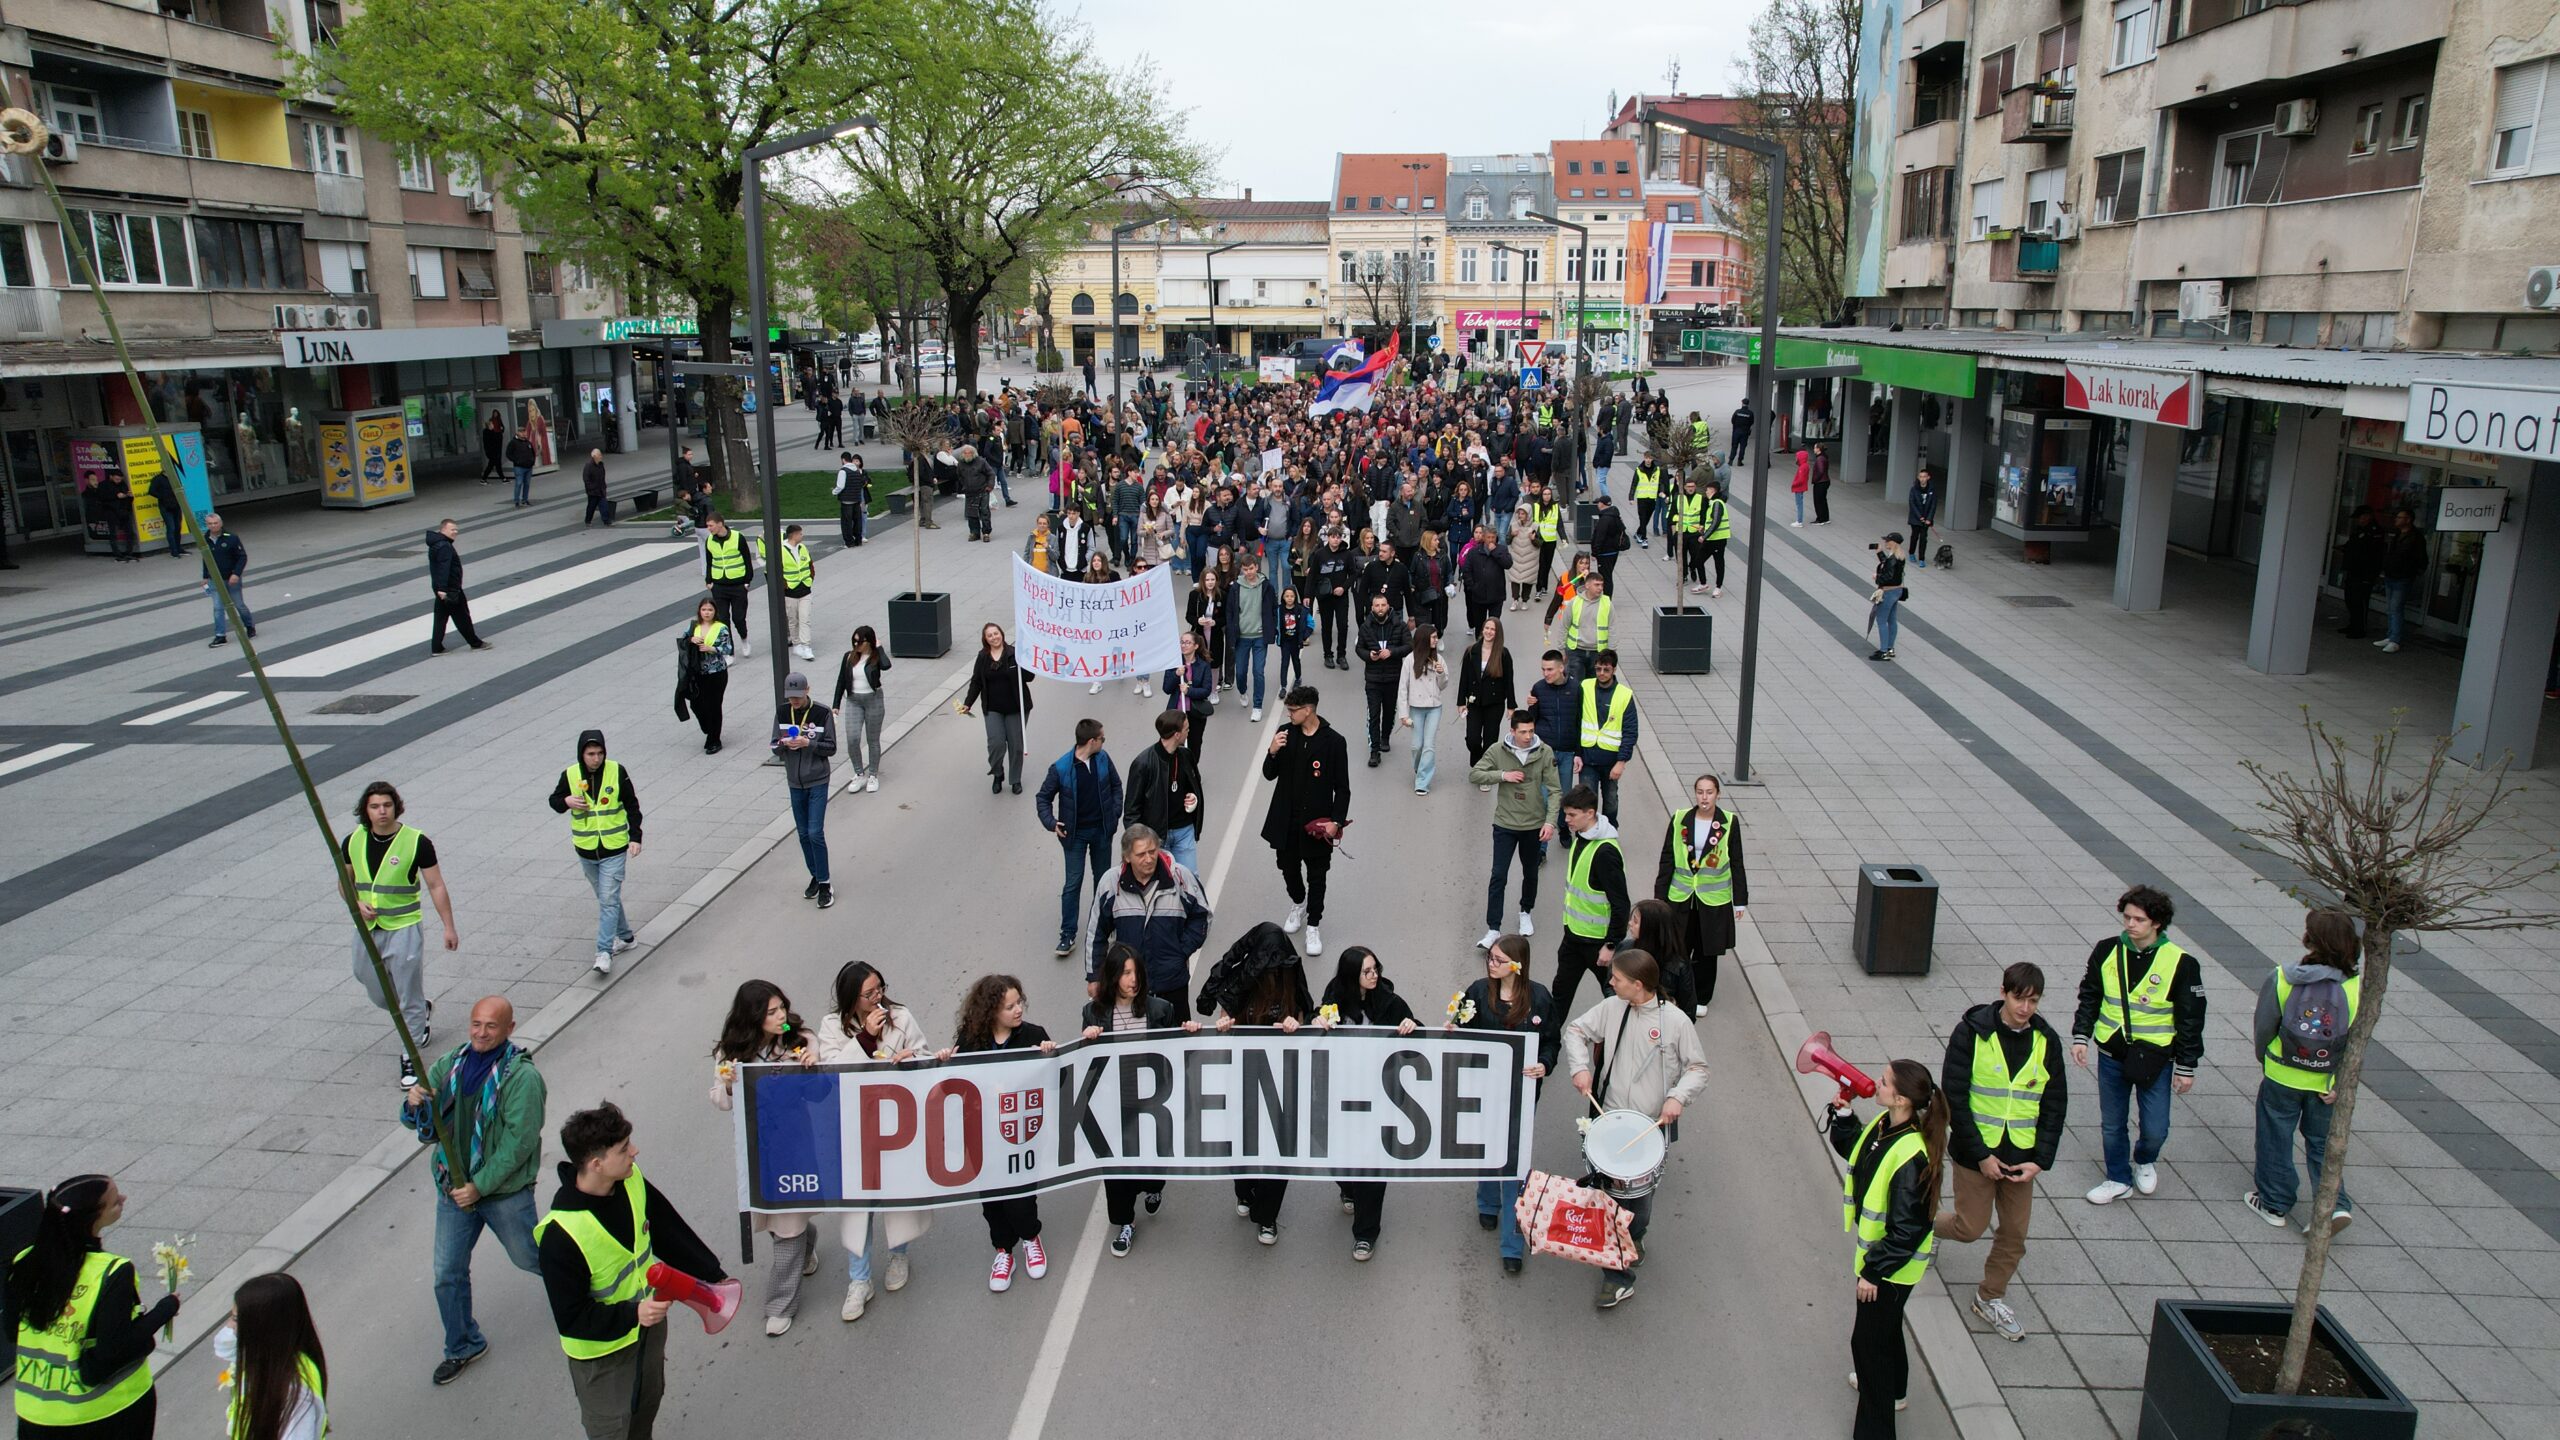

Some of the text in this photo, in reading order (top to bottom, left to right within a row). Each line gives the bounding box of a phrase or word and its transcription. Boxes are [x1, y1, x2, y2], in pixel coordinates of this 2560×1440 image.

[2089, 376, 2159, 411] Lak korak
[2445, 502, 2496, 518] Bonatti
[1023, 571, 1054, 607] Крај
[1058, 591, 1075, 609] је
[1080, 600, 1114, 612] кад
[1119, 580, 1152, 608] МИ
[1026, 607, 1103, 641] Кажемо
[1108, 625, 1129, 641] да
[1133, 619, 1147, 638] је
[1032, 644, 1135, 678] КРАЈ!!!
[2292, 1056, 2330, 1068] adidas
[859, 1049, 1490, 1191] PO KRENI-SE
[778, 1174, 819, 1193] SRB
